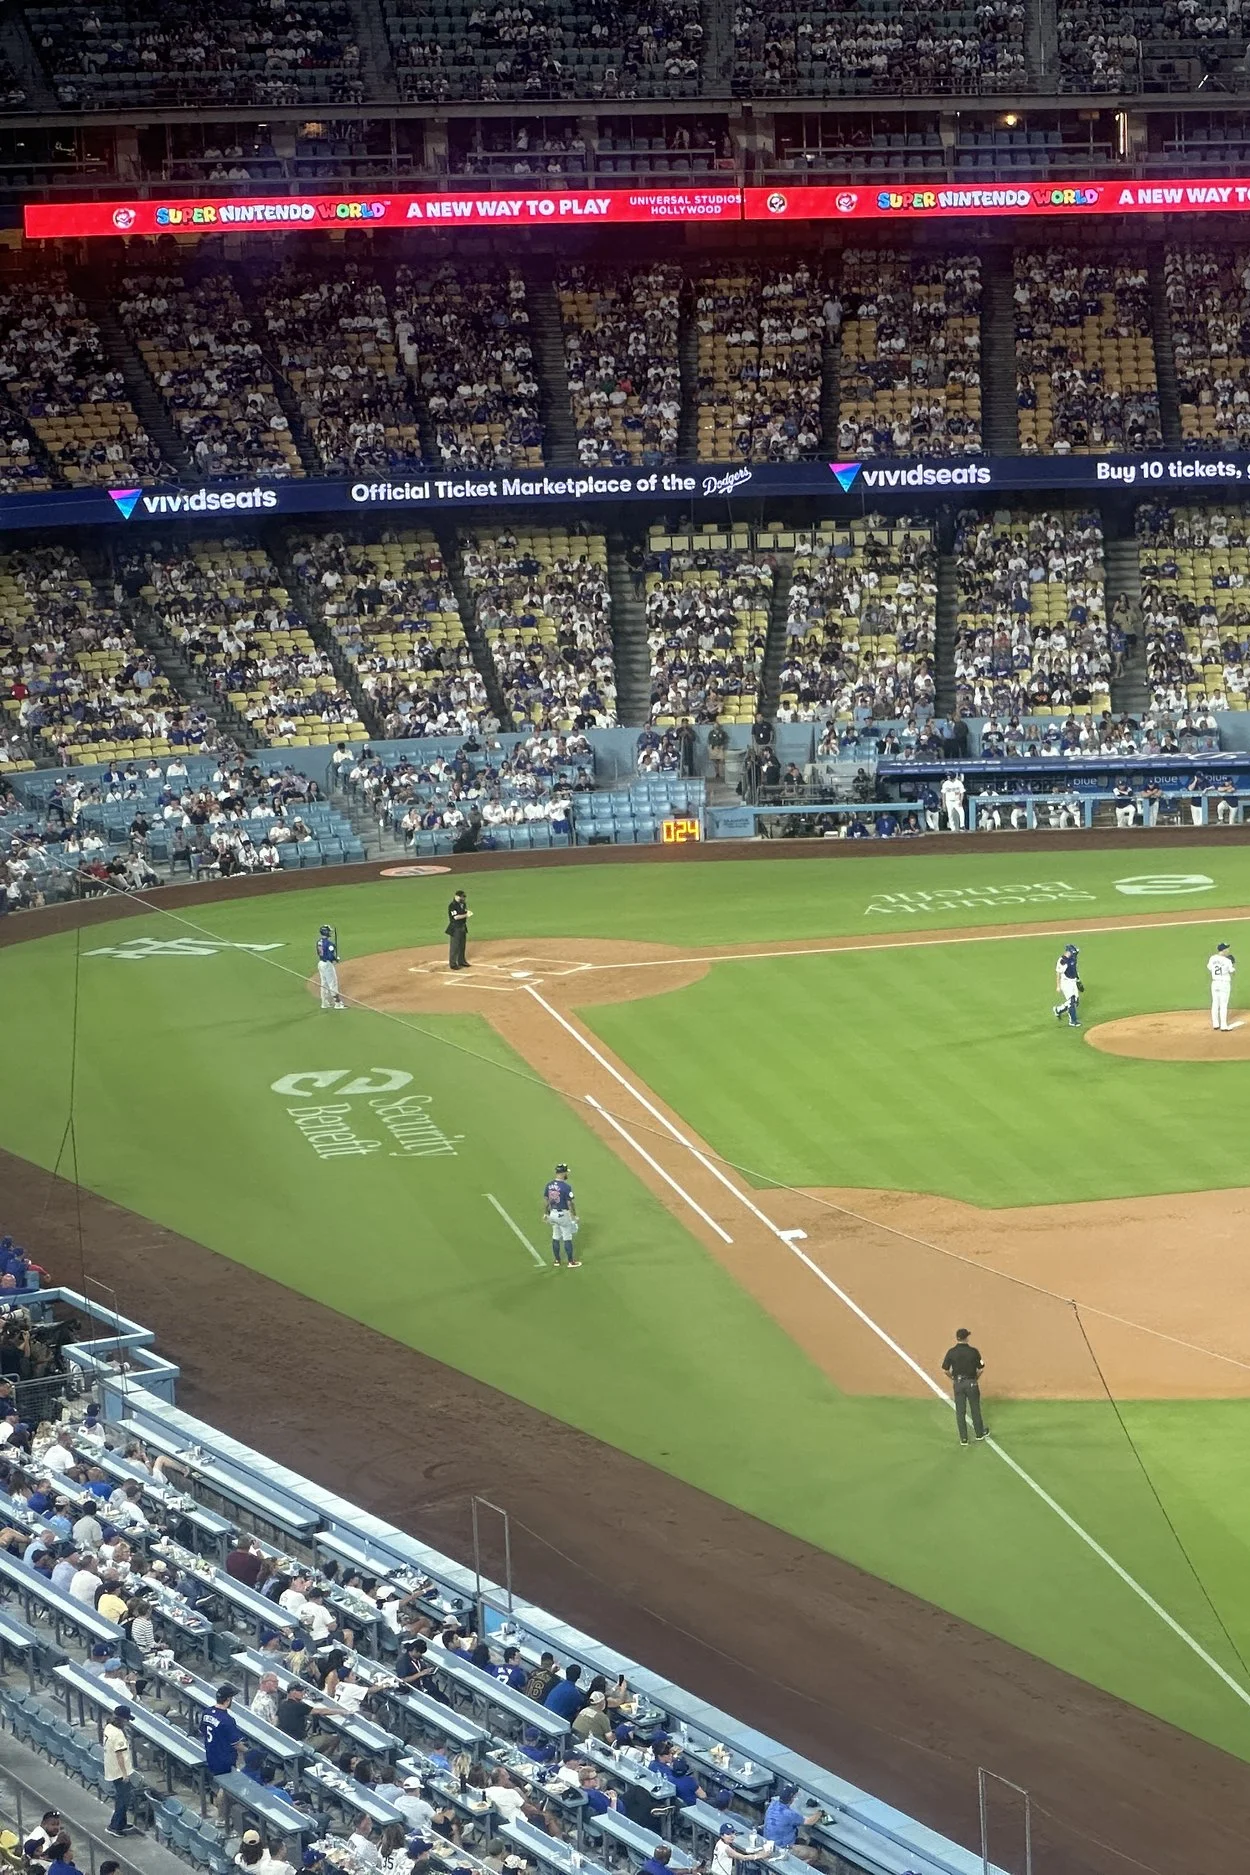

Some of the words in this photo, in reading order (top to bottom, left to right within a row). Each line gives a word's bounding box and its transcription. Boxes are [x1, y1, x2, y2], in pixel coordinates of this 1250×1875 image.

[629, 195, 691, 205] UNIVERSAL
[695, 194, 741, 204] STUDIOS
[877, 191, 936, 210] SUPER
[938, 189, 1031, 208] NINTENDO
[1118, 189, 1135, 204] A
[1137, 188, 1185, 203] NEW
[1187, 187, 1235, 203] WAY
[156, 206, 216, 225] SUPER
[219, 205, 315, 223] NINTENDO
[407, 202, 424, 218] A
[427, 201, 471, 218] NEW
[476, 200, 527, 216] WAY
[529, 199, 556, 215] TO
[560, 198, 611, 214] PLAY
[651, 205, 722, 215] HOLLYWOOD
[863, 464, 991, 487] vividseats
[1097, 462, 1135, 483] Buy
[1140, 462, 1164, 479] 10
[1168, 460, 1242, 480] tickets,
[351, 481, 430, 503] Official
[435, 478, 497, 500] Ticket
[502, 475, 632, 497] Marketplace
[636, 475, 658, 492] of
[660, 474, 696, 491] the
[702, 467, 752, 496] Dodgers
[143, 487, 277, 513] vividseats
[864, 891, 1097, 915] Security
[871, 881, 1077, 903] Benefit
[286, 1102, 382, 1160] Benefit
[368, 1095, 466, 1156] Security
[206, 1725, 213, 1743] 5
